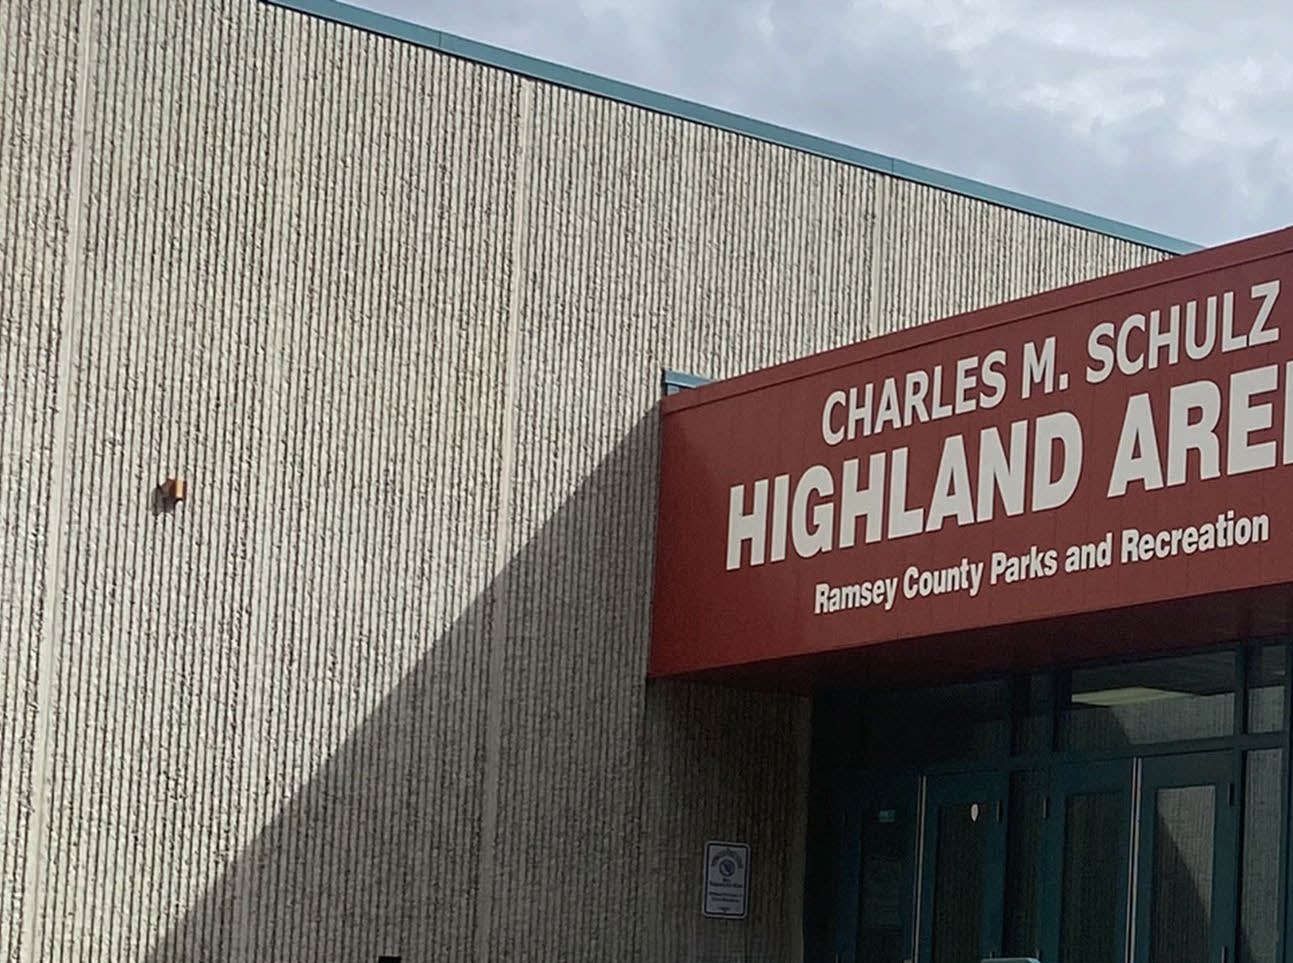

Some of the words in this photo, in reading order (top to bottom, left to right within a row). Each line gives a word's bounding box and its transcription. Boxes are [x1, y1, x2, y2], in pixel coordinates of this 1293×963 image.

[822, 351, 1007, 445] CHARLES
[1021, 336, 1069, 399] M.
[1086, 279, 1281, 383] SCHULZ
[725, 411, 1084, 571] HIGHLAND
[814, 576, 899, 614] Ramsey
[903, 558, 984, 597] County
[990, 545, 1058, 585] Parks
[1065, 532, 1113, 573] and
[1120, 509, 1270, 564] Recreation
